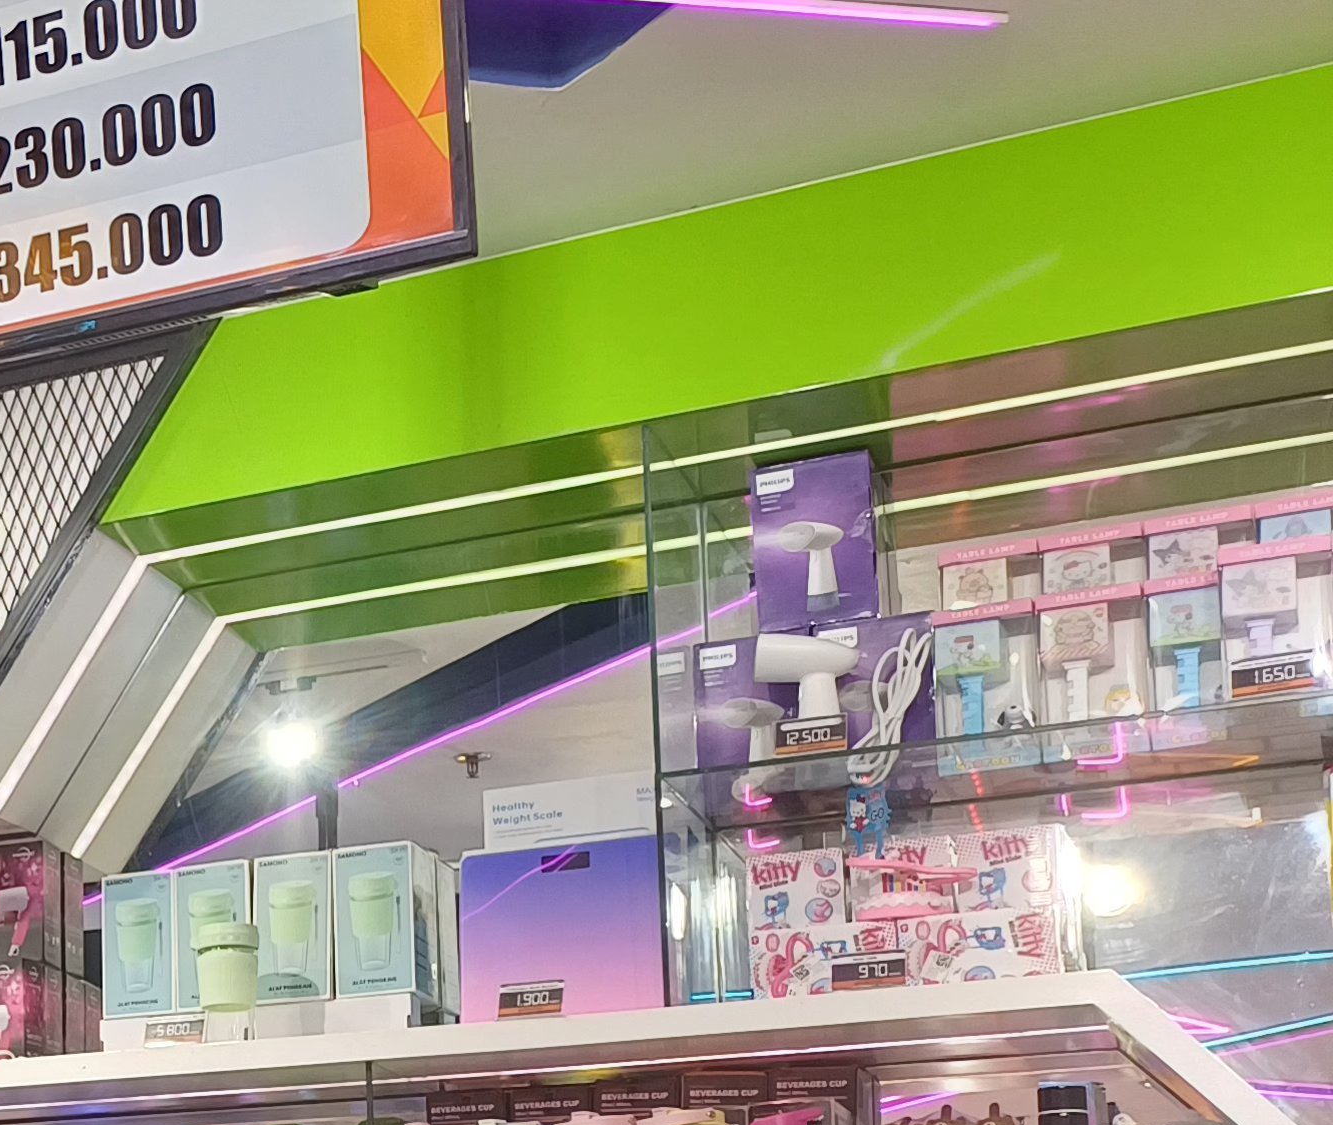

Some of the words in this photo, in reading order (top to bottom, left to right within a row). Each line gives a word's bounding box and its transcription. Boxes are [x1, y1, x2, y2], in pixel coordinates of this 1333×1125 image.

[1255, 665, 1296, 684] 1.650
[786, 727, 831, 745] 12.500
[492, 801, 535, 813] Healthy
[493, 814, 531, 826] Weight
[533, 811, 563, 821] Scale
[751, 860, 802, 885] kitty
[858, 963, 888, 979] 970
[516, 992, 549, 1007] 1.900
[776, 1080, 827, 1089] BEVERAGES
[829, 1079, 847, 1088] CUP
[601, 1092, 649, 1101] BEVERAGES
[651, 1091, 669, 1100] CUP
[690, 1090, 739, 1098] BEVERAGES
[740, 1089, 758, 1097] CUP
[431, 1105, 476, 1114] BEVERAGES
[478, 1104, 494, 1112] CUP
[515, 1101, 561, 1110] BEVERAGES
[563, 1100, 580, 1108] CUP
